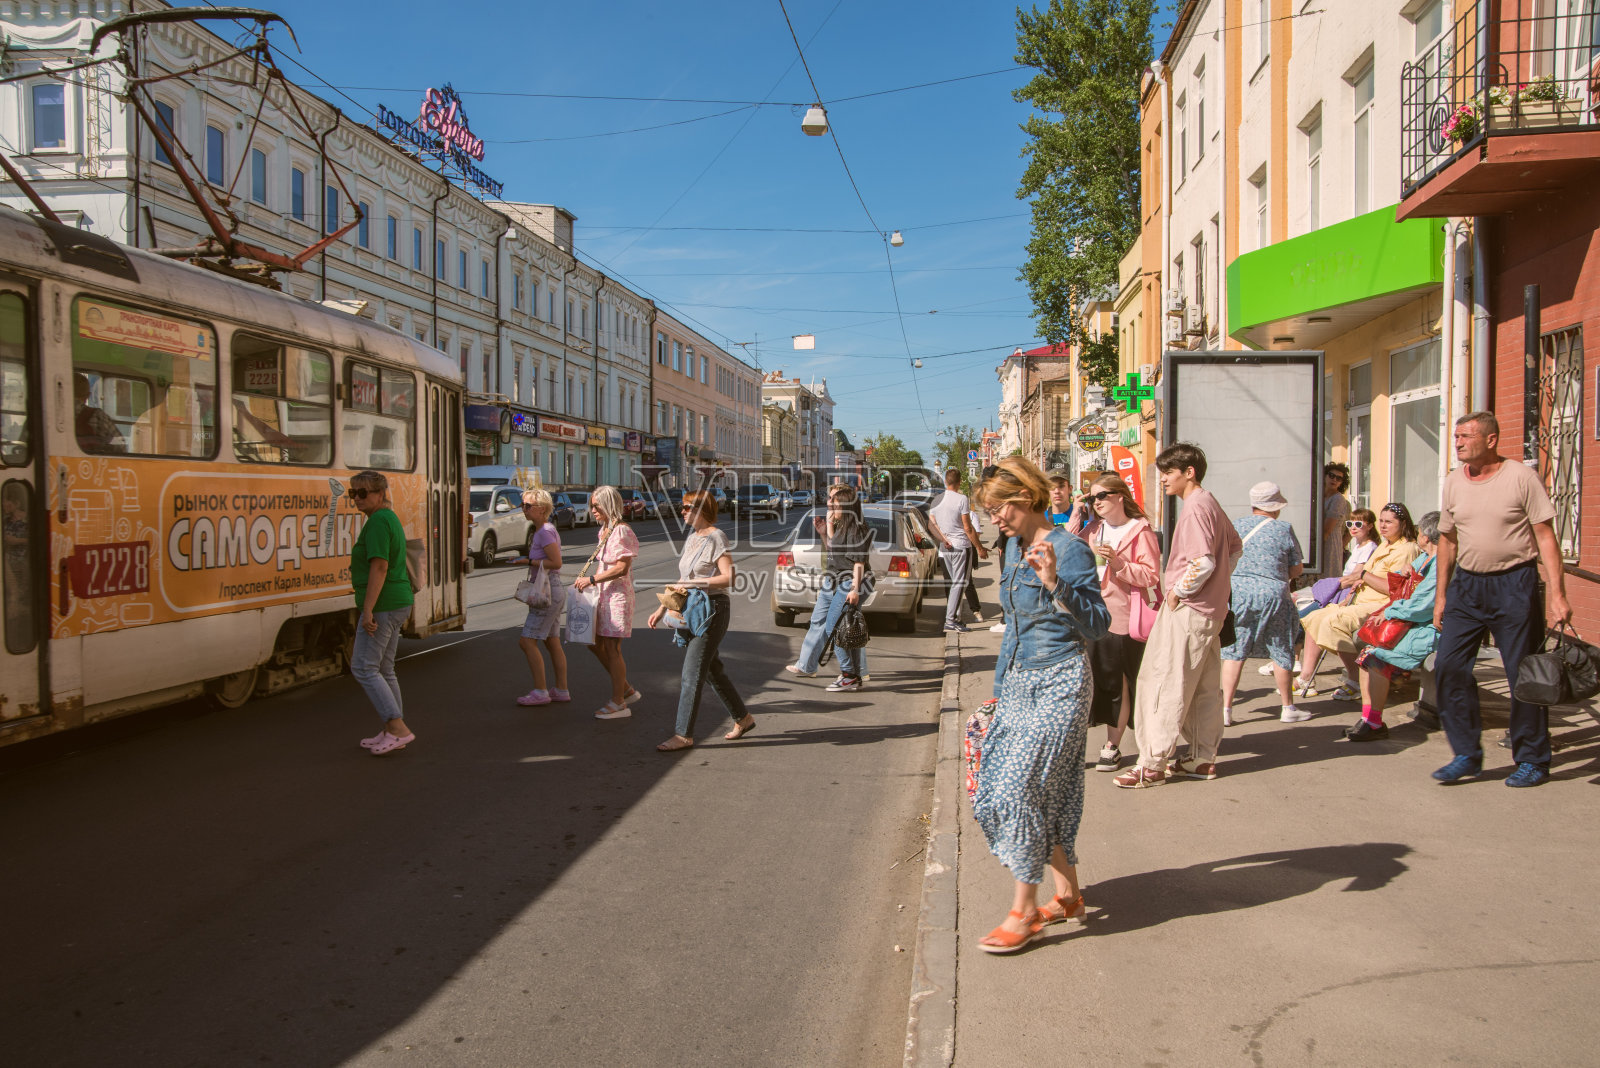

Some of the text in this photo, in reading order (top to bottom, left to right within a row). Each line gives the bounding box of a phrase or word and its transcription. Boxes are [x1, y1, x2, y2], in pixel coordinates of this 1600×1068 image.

[173, 494, 228, 517] рынок
[232, 493, 329, 514] строительных
[85, 545, 149, 596] 2228
[274, 576, 301, 591] Карла
[303, 572, 337, 587] Маркса,
